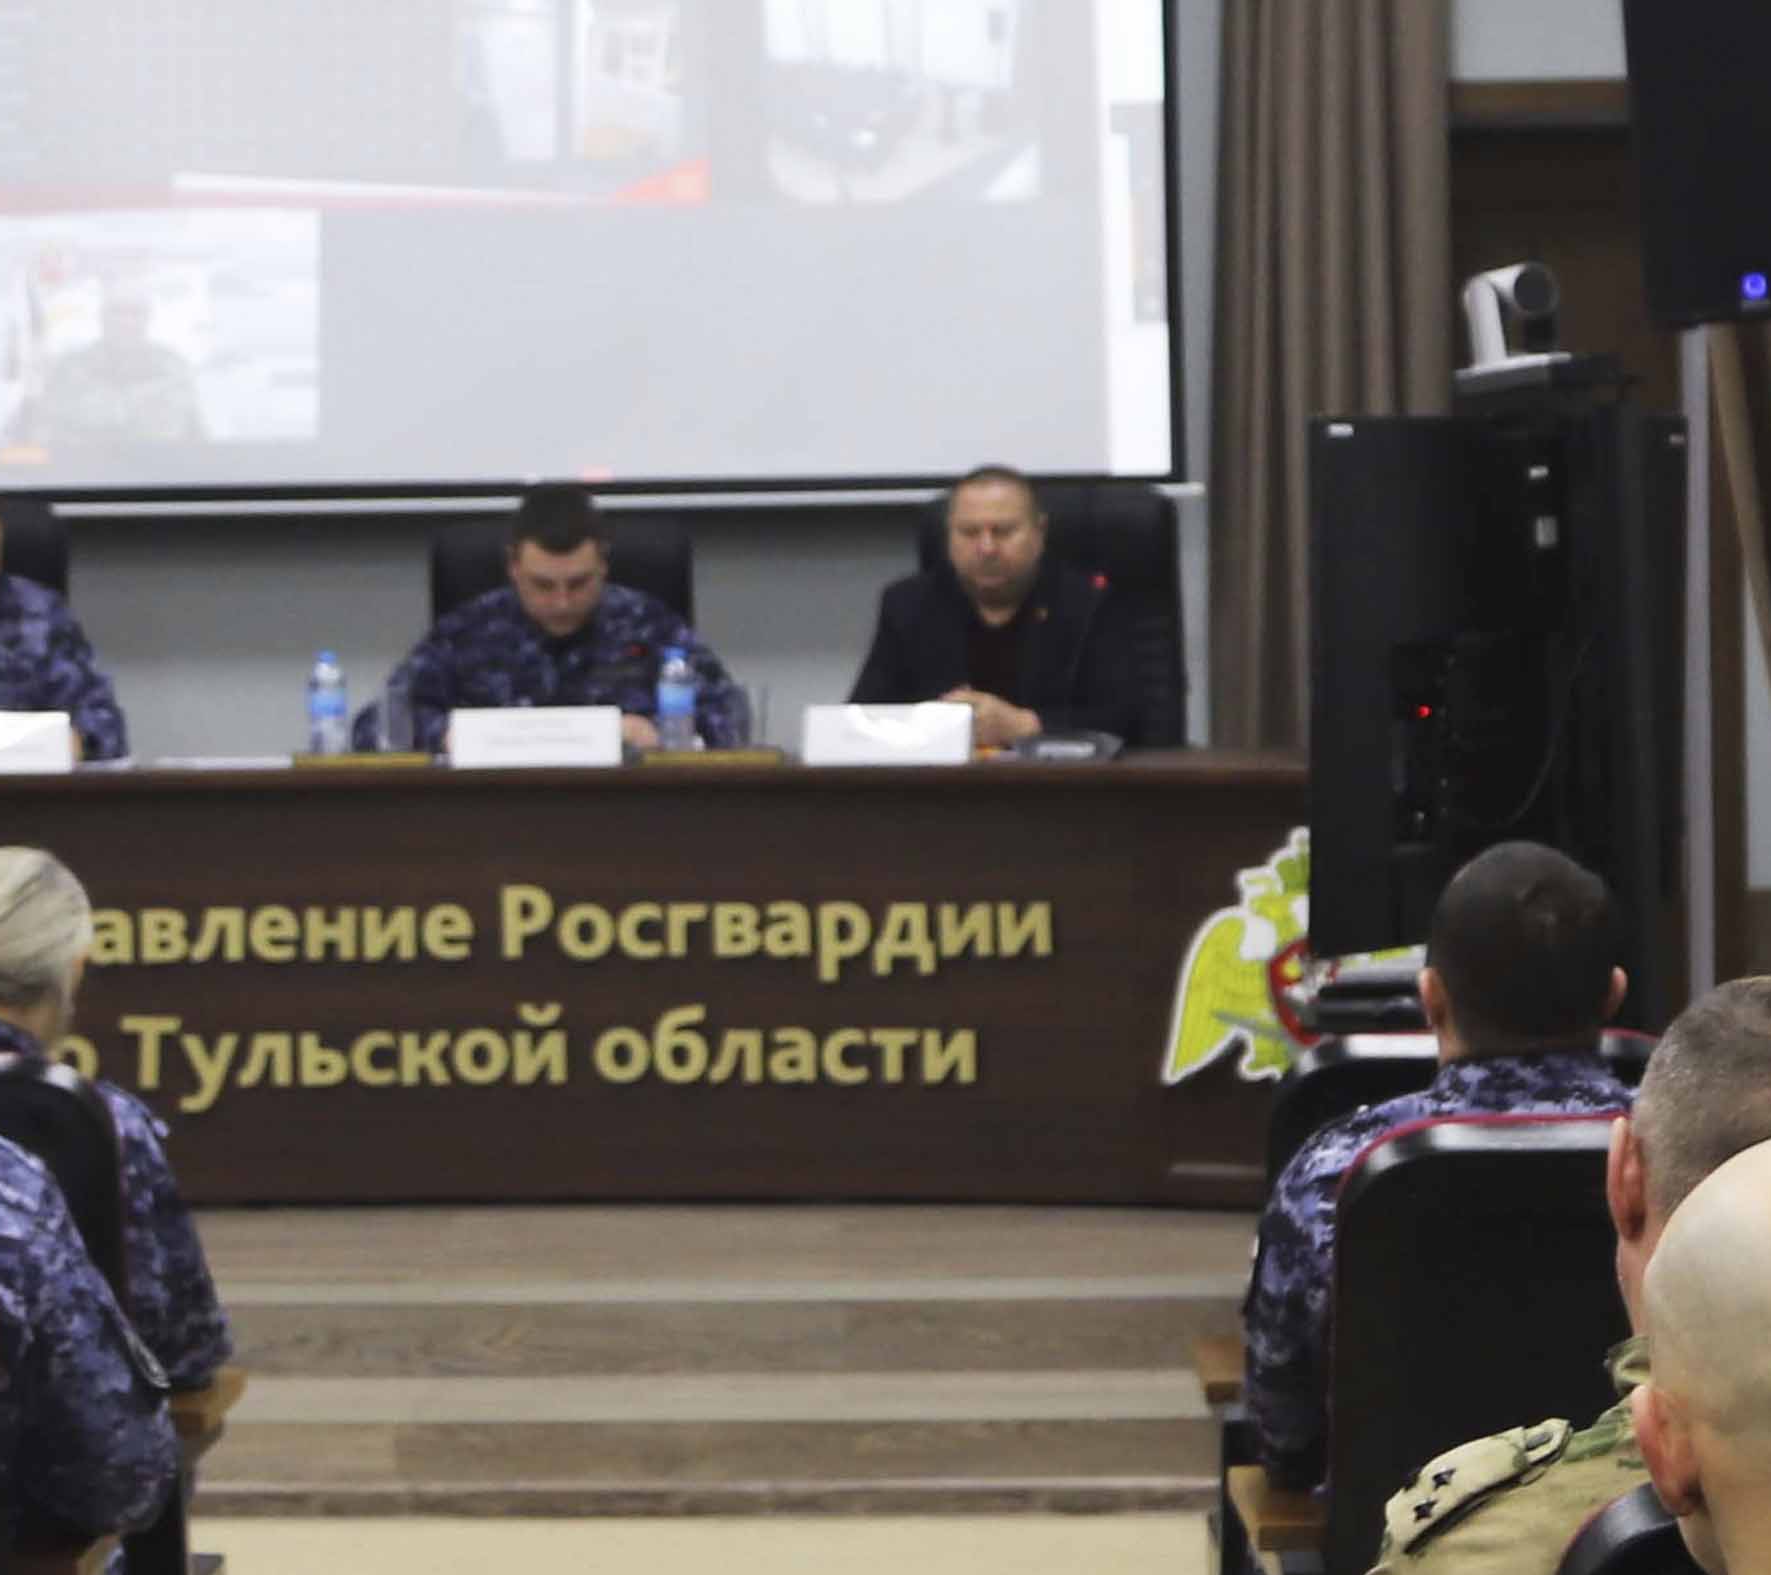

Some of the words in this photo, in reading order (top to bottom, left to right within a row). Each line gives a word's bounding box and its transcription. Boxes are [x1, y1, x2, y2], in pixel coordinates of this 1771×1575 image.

[501, 883, 1051, 978] Росгвардии
[119, 1003, 567, 1109] Тульской
[593, 1004, 976, 1082] области
